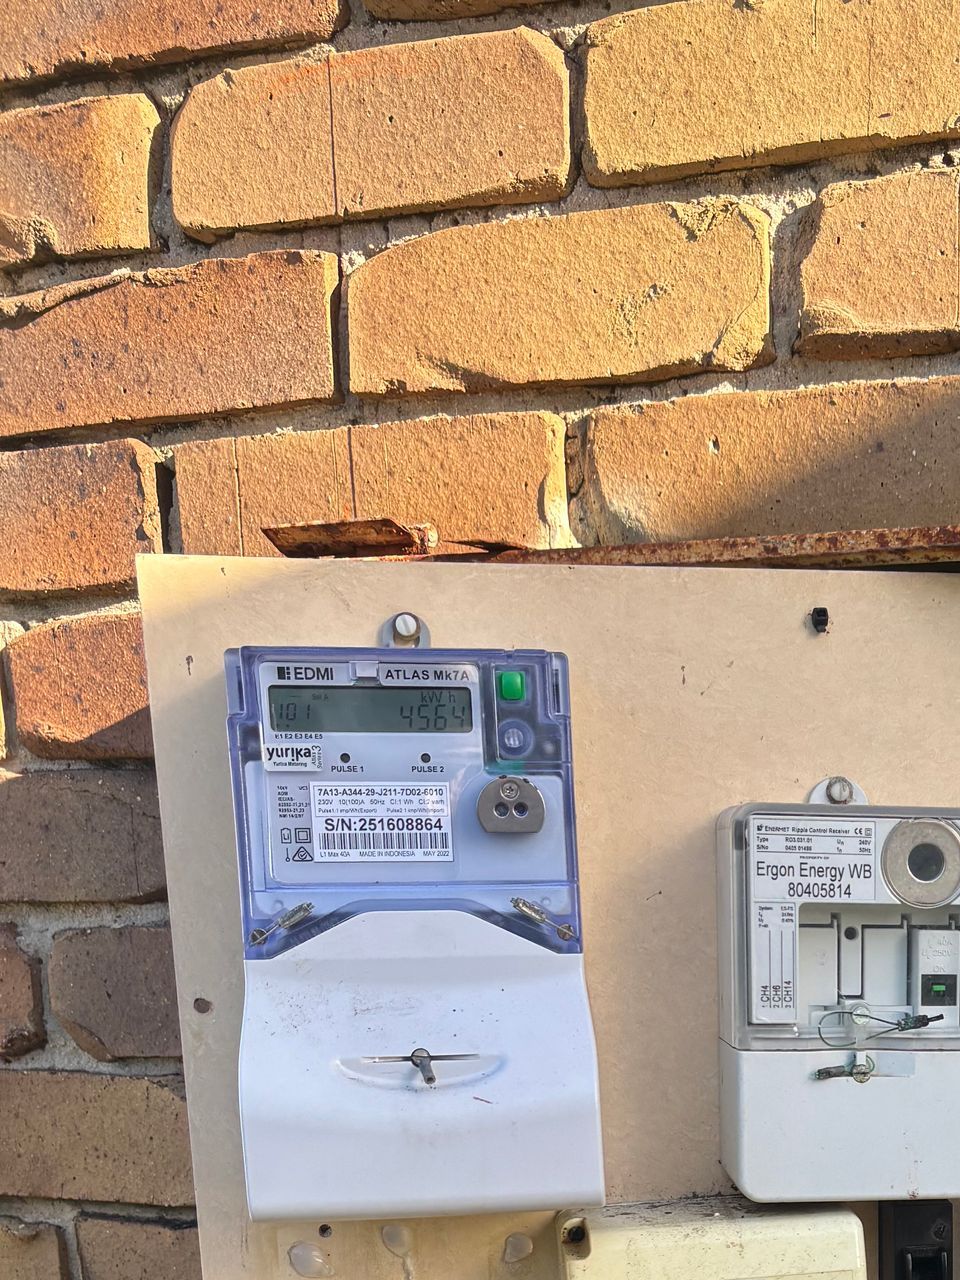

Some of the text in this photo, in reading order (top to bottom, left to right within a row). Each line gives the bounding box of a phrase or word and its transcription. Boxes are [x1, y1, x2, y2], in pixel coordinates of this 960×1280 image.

[294, 667, 333, 680] EDMI
[385, 670, 470, 680] ATLAS Mk7A
[401, 704, 465, 730] 4564
[331, 765, 364, 773] PULSE 1
[411, 765, 445, 773] PULSE 2
[324, 818, 443, 832] S/N:251608864
[756, 861, 873, 882] Ergon Energy WB
[788, 882, 852, 898] 80405814
[760, 985, 770, 1003] CH4
[783, 980, 793, 1003] CH14
